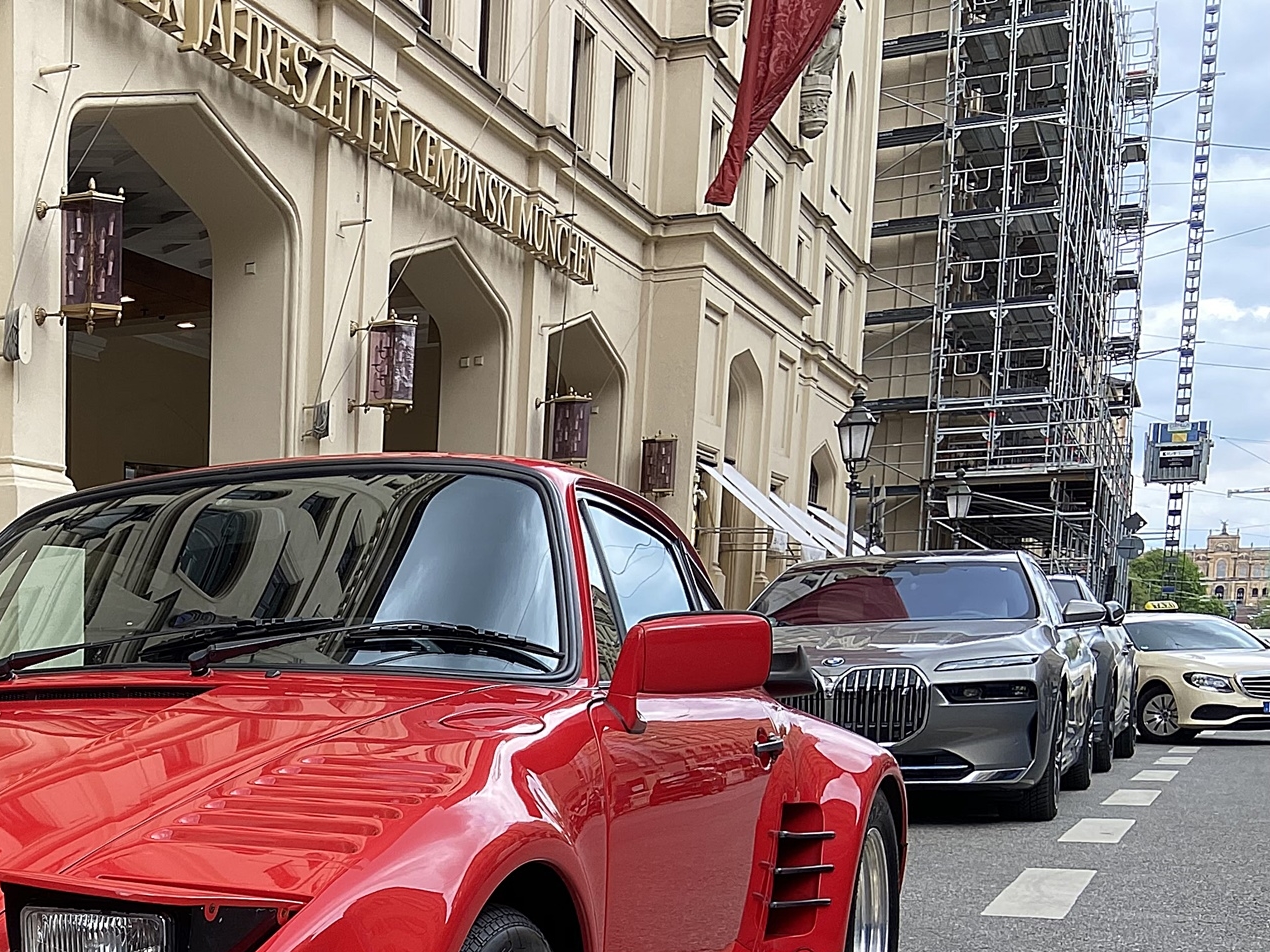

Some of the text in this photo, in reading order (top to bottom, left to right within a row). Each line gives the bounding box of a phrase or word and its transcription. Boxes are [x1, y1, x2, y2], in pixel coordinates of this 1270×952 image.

[180, 0, 598, 286] JAHRESZEITEN KEMPINSKI MÜNCHEN
